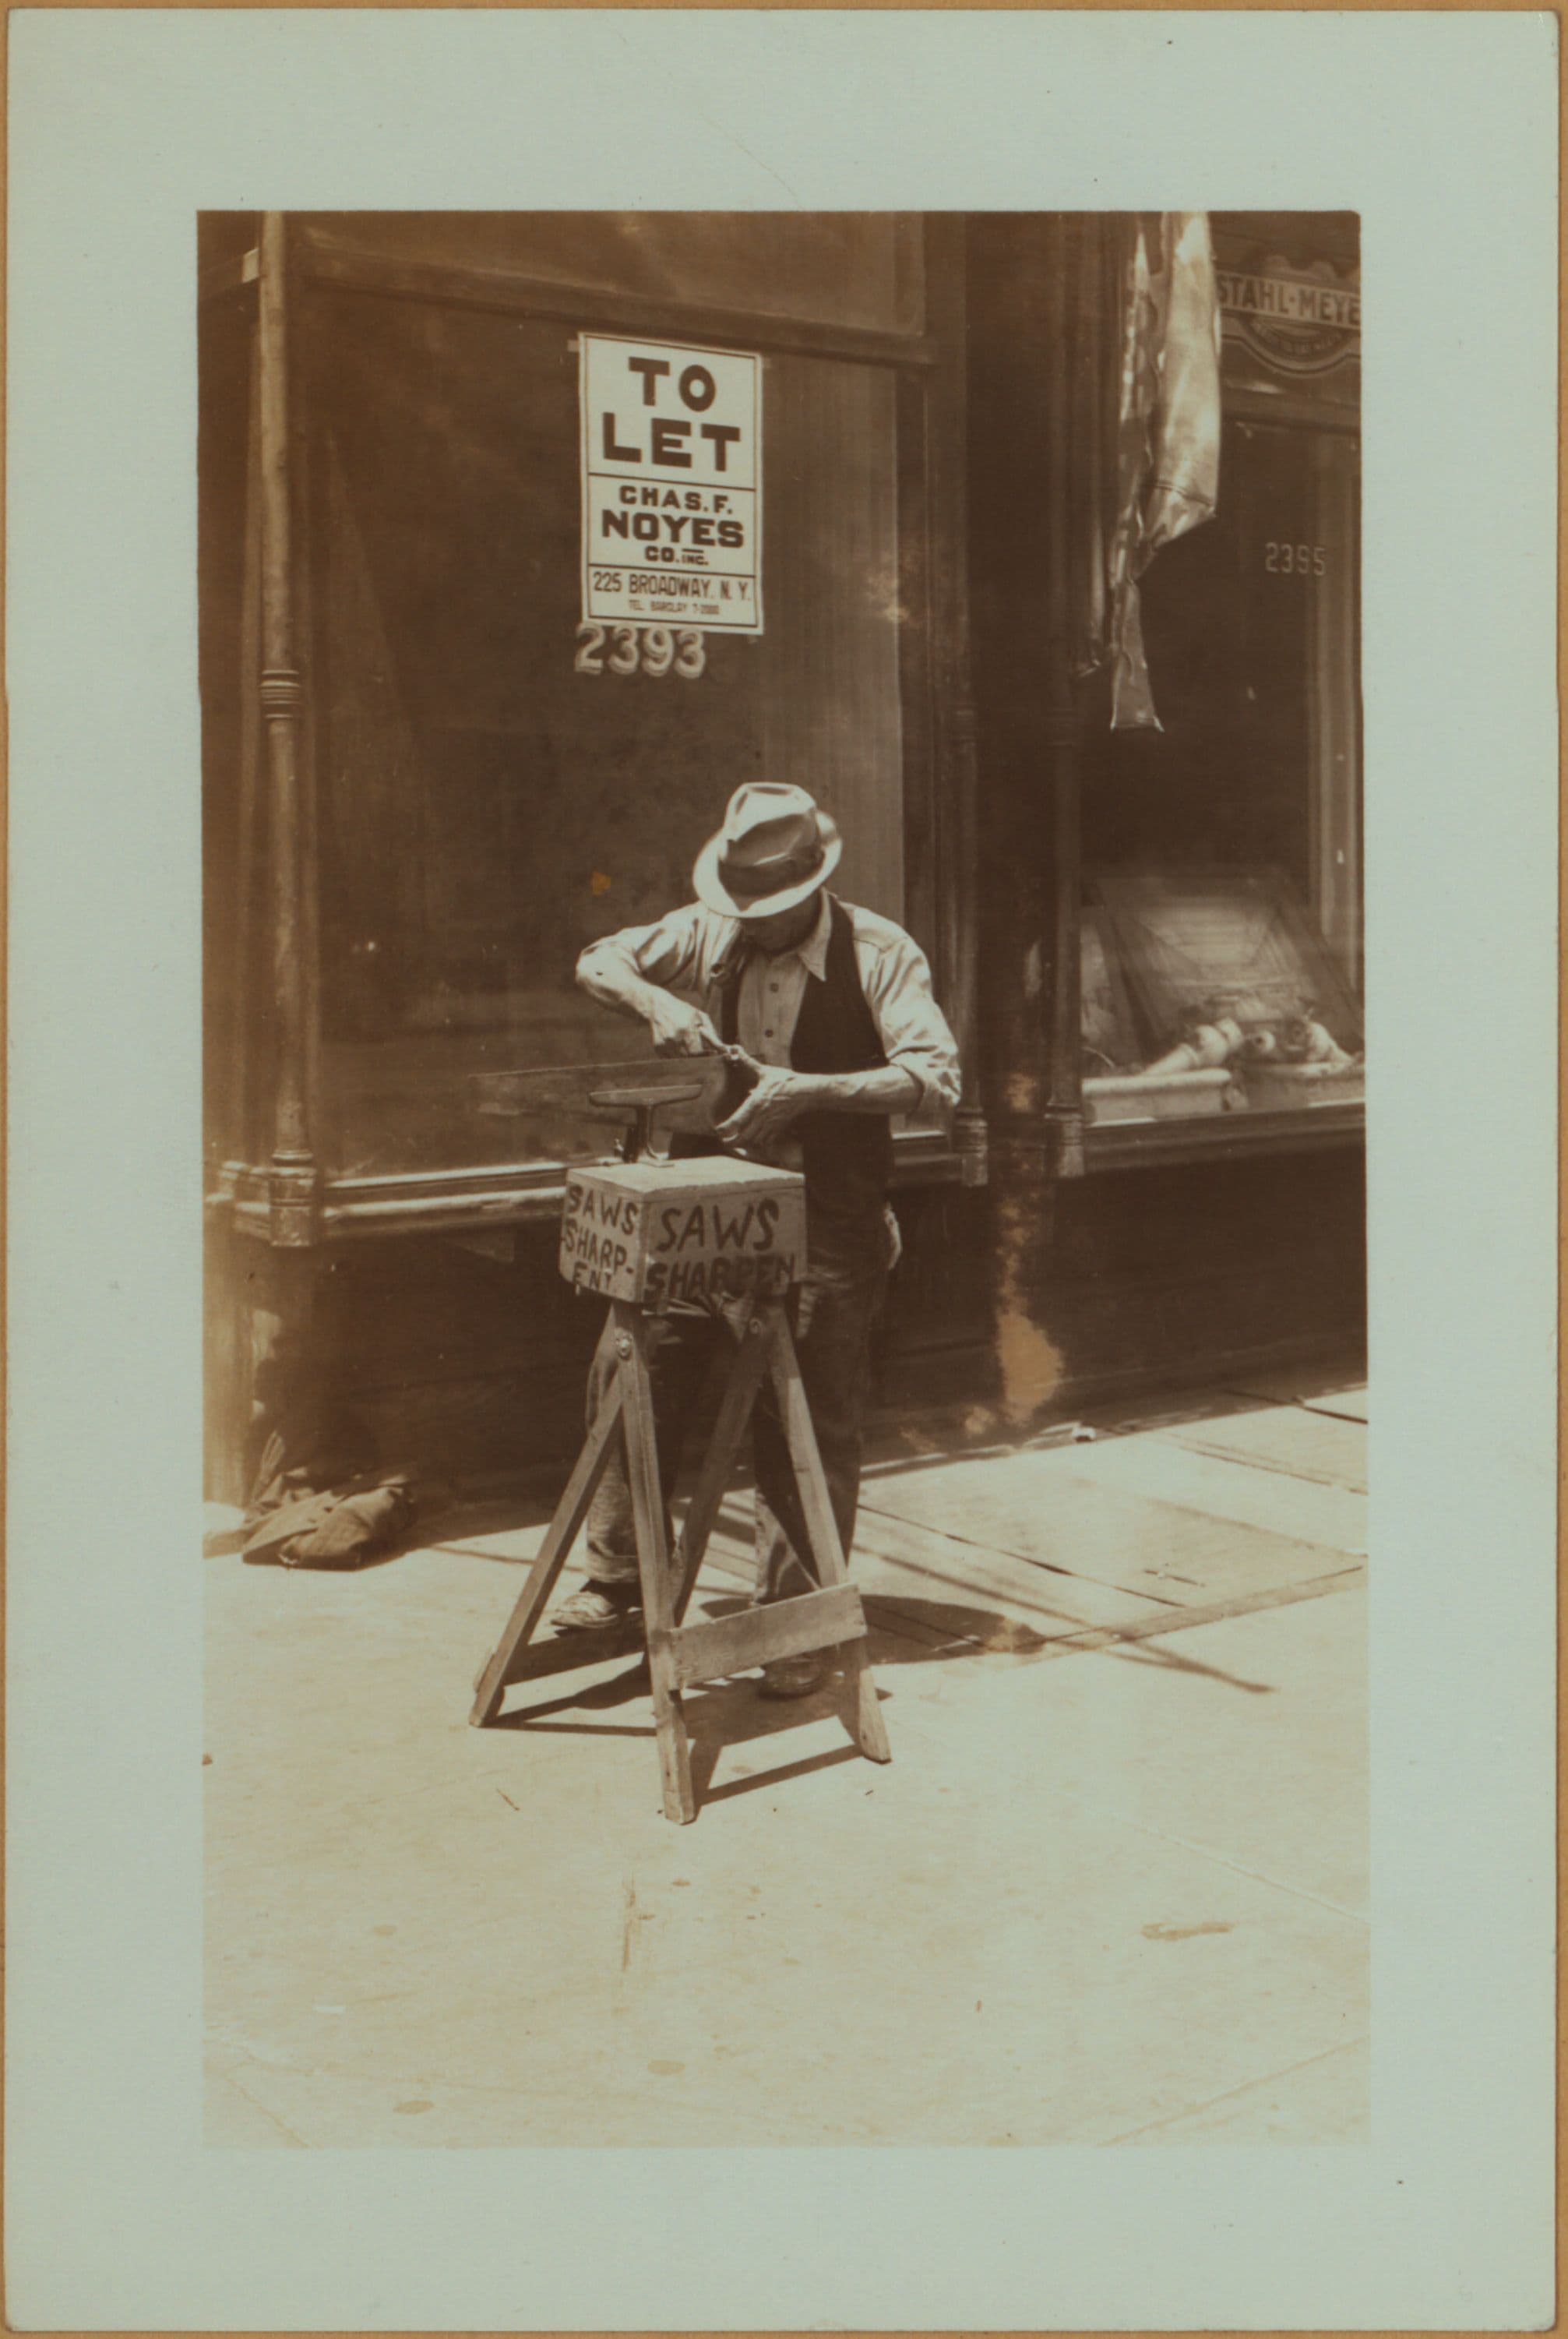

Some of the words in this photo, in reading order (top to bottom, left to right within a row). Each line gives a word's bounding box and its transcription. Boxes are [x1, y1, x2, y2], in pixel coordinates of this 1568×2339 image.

[629, 356, 716, 412] TO
[602, 412, 740, 472] LET
[619, 485, 709, 513] CHAS.
[713, 494, 733, 515] F.
[602, 509, 744, 548] NOYES
[645, 545, 679, 563] CO.
[593, 571, 622, 592] 225
[738, 581, 752, 602] Y.
[575, 626, 706, 679] 2393
[567, 1184, 639, 1235] SAWS
[657, 1199, 779, 1252] SAWS
